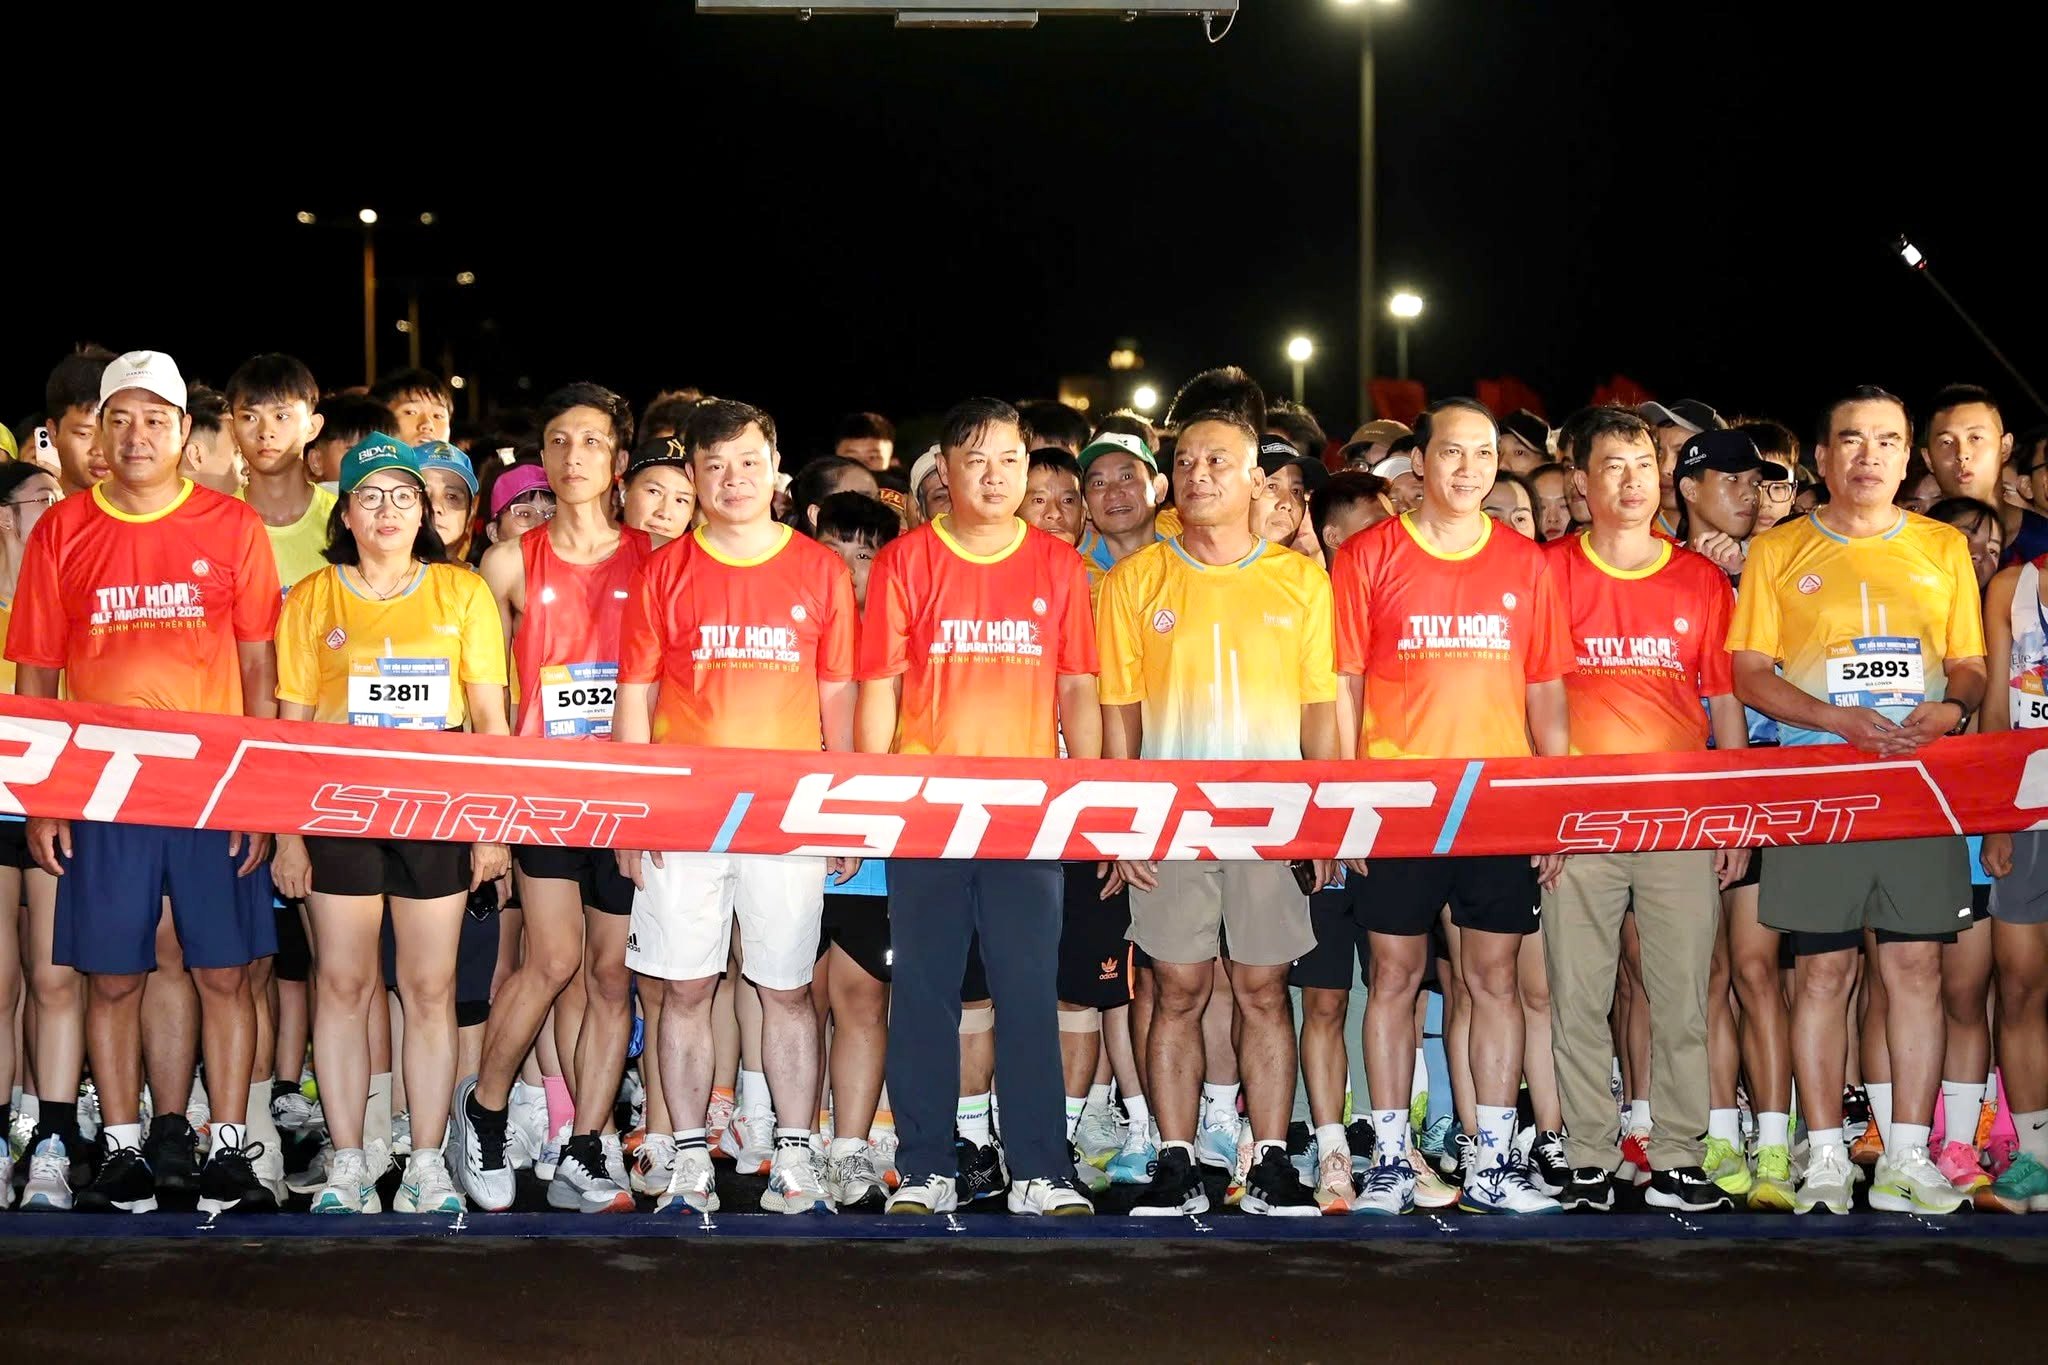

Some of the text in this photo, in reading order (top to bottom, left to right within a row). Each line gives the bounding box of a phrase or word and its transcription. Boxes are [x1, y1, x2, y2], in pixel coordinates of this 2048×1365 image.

[358, 445, 387, 460] BIDV
[96, 580, 190, 611] TUY HÒA
[114, 606, 176, 621] MARATHON
[940, 616, 1030, 642] TUY HÒA
[1409, 612, 1501, 638] TUY HÒA
[699, 623, 787, 649] TUY HÒA
[1397, 638, 1424, 651] HALF
[1426, 636, 1487, 650] MARATHON
[714, 647, 773, 660] MARATHON
[955, 641, 1015, 654] MARATHON
[1584, 635, 1626, 658] TUY
[1842, 660, 1910, 680] 52893
[368, 683, 429, 701] 52811
[1834, 693, 1859, 707] 5KM
[354, 714, 380, 728] 5KM
[550, 720, 576, 736] 5KM
[299, 783, 650, 848] START
[779, 773, 1438, 860] START
[1554, 794, 1881, 854] START
